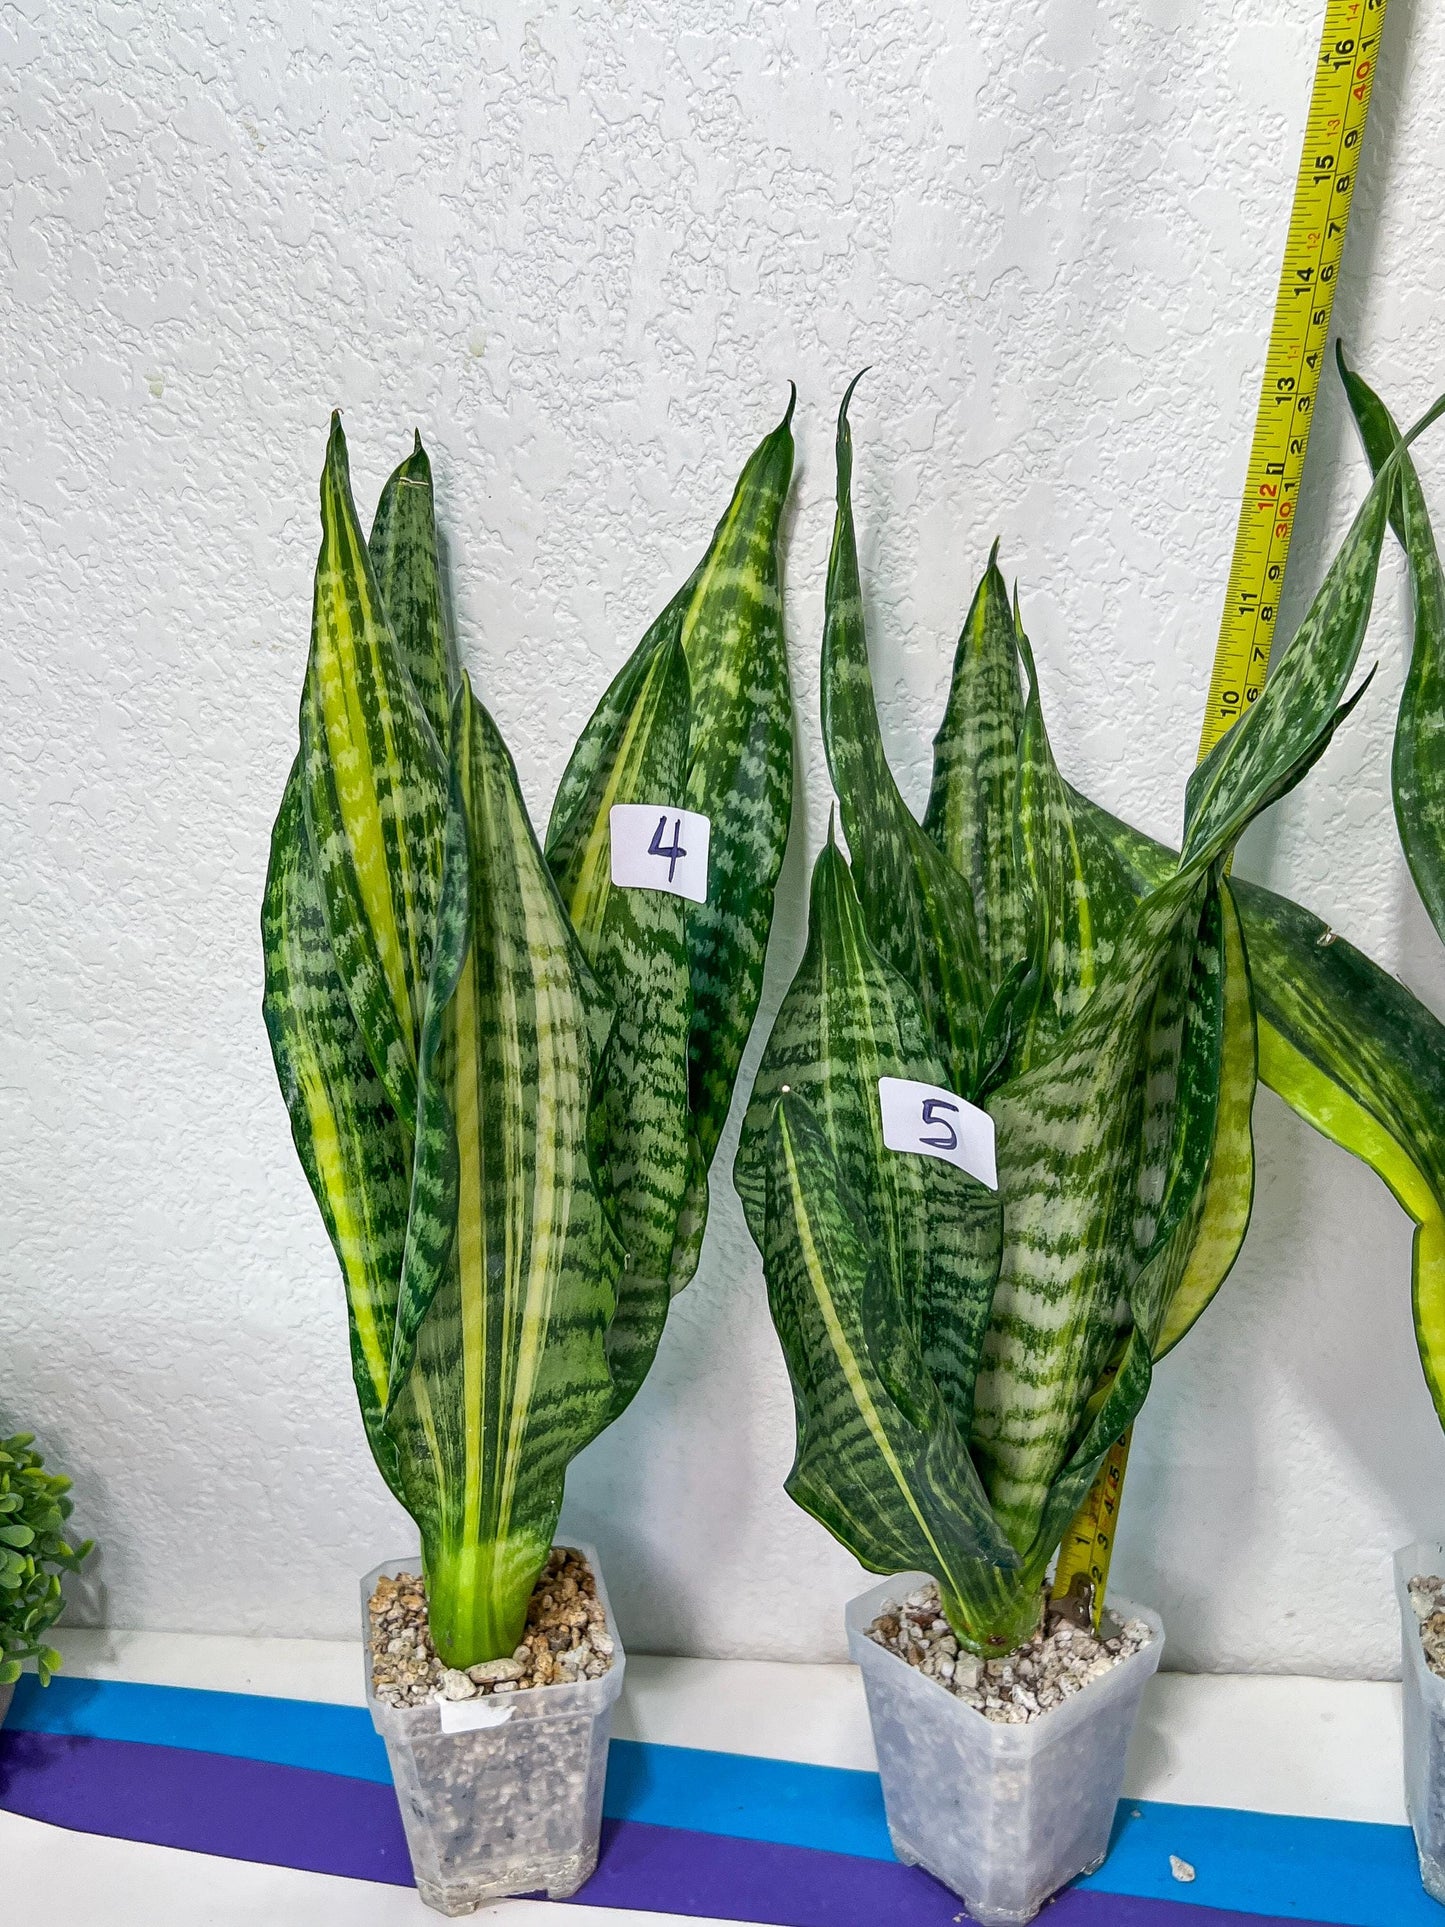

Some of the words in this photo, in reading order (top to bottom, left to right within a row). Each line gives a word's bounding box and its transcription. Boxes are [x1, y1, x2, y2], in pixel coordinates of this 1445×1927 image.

[1333, 39, 1355, 71] 16
[1353, 61, 1371, 100] 40
[1344, 130, 1359, 148] 9
[1313, 154, 1335, 185] 15
[1336, 175, 1350, 193] 8
[1327, 221, 1342, 239] 7
[1294, 268, 1314, 297] 14
[1320, 265, 1334, 282] 6
[1312, 309, 1326, 325] 5
[1306, 352, 1318, 369] 4
[1275, 376, 1296, 405] 13
[1298, 396, 1311, 412] 3
[1290, 439, 1304, 455] 2
[1283, 481, 1296, 493] 1
[1257, 483, 1277, 511] 12
[1275, 502, 1291, 538] 30
[1268, 565, 1281, 580] 9
[1238, 592, 1258, 616] 11
[1261, 606, 1274, 621] 8
[1254, 646, 1265, 662] 7
[1220, 690, 1239, 718] 10
[1246, 688, 1259, 703] 6
[647, 815, 687, 883] 4
[919, 1099, 959, 1150] 5
[1075, 1536, 1090, 1546] 1
[1091, 1566, 1103, 1584] 2
